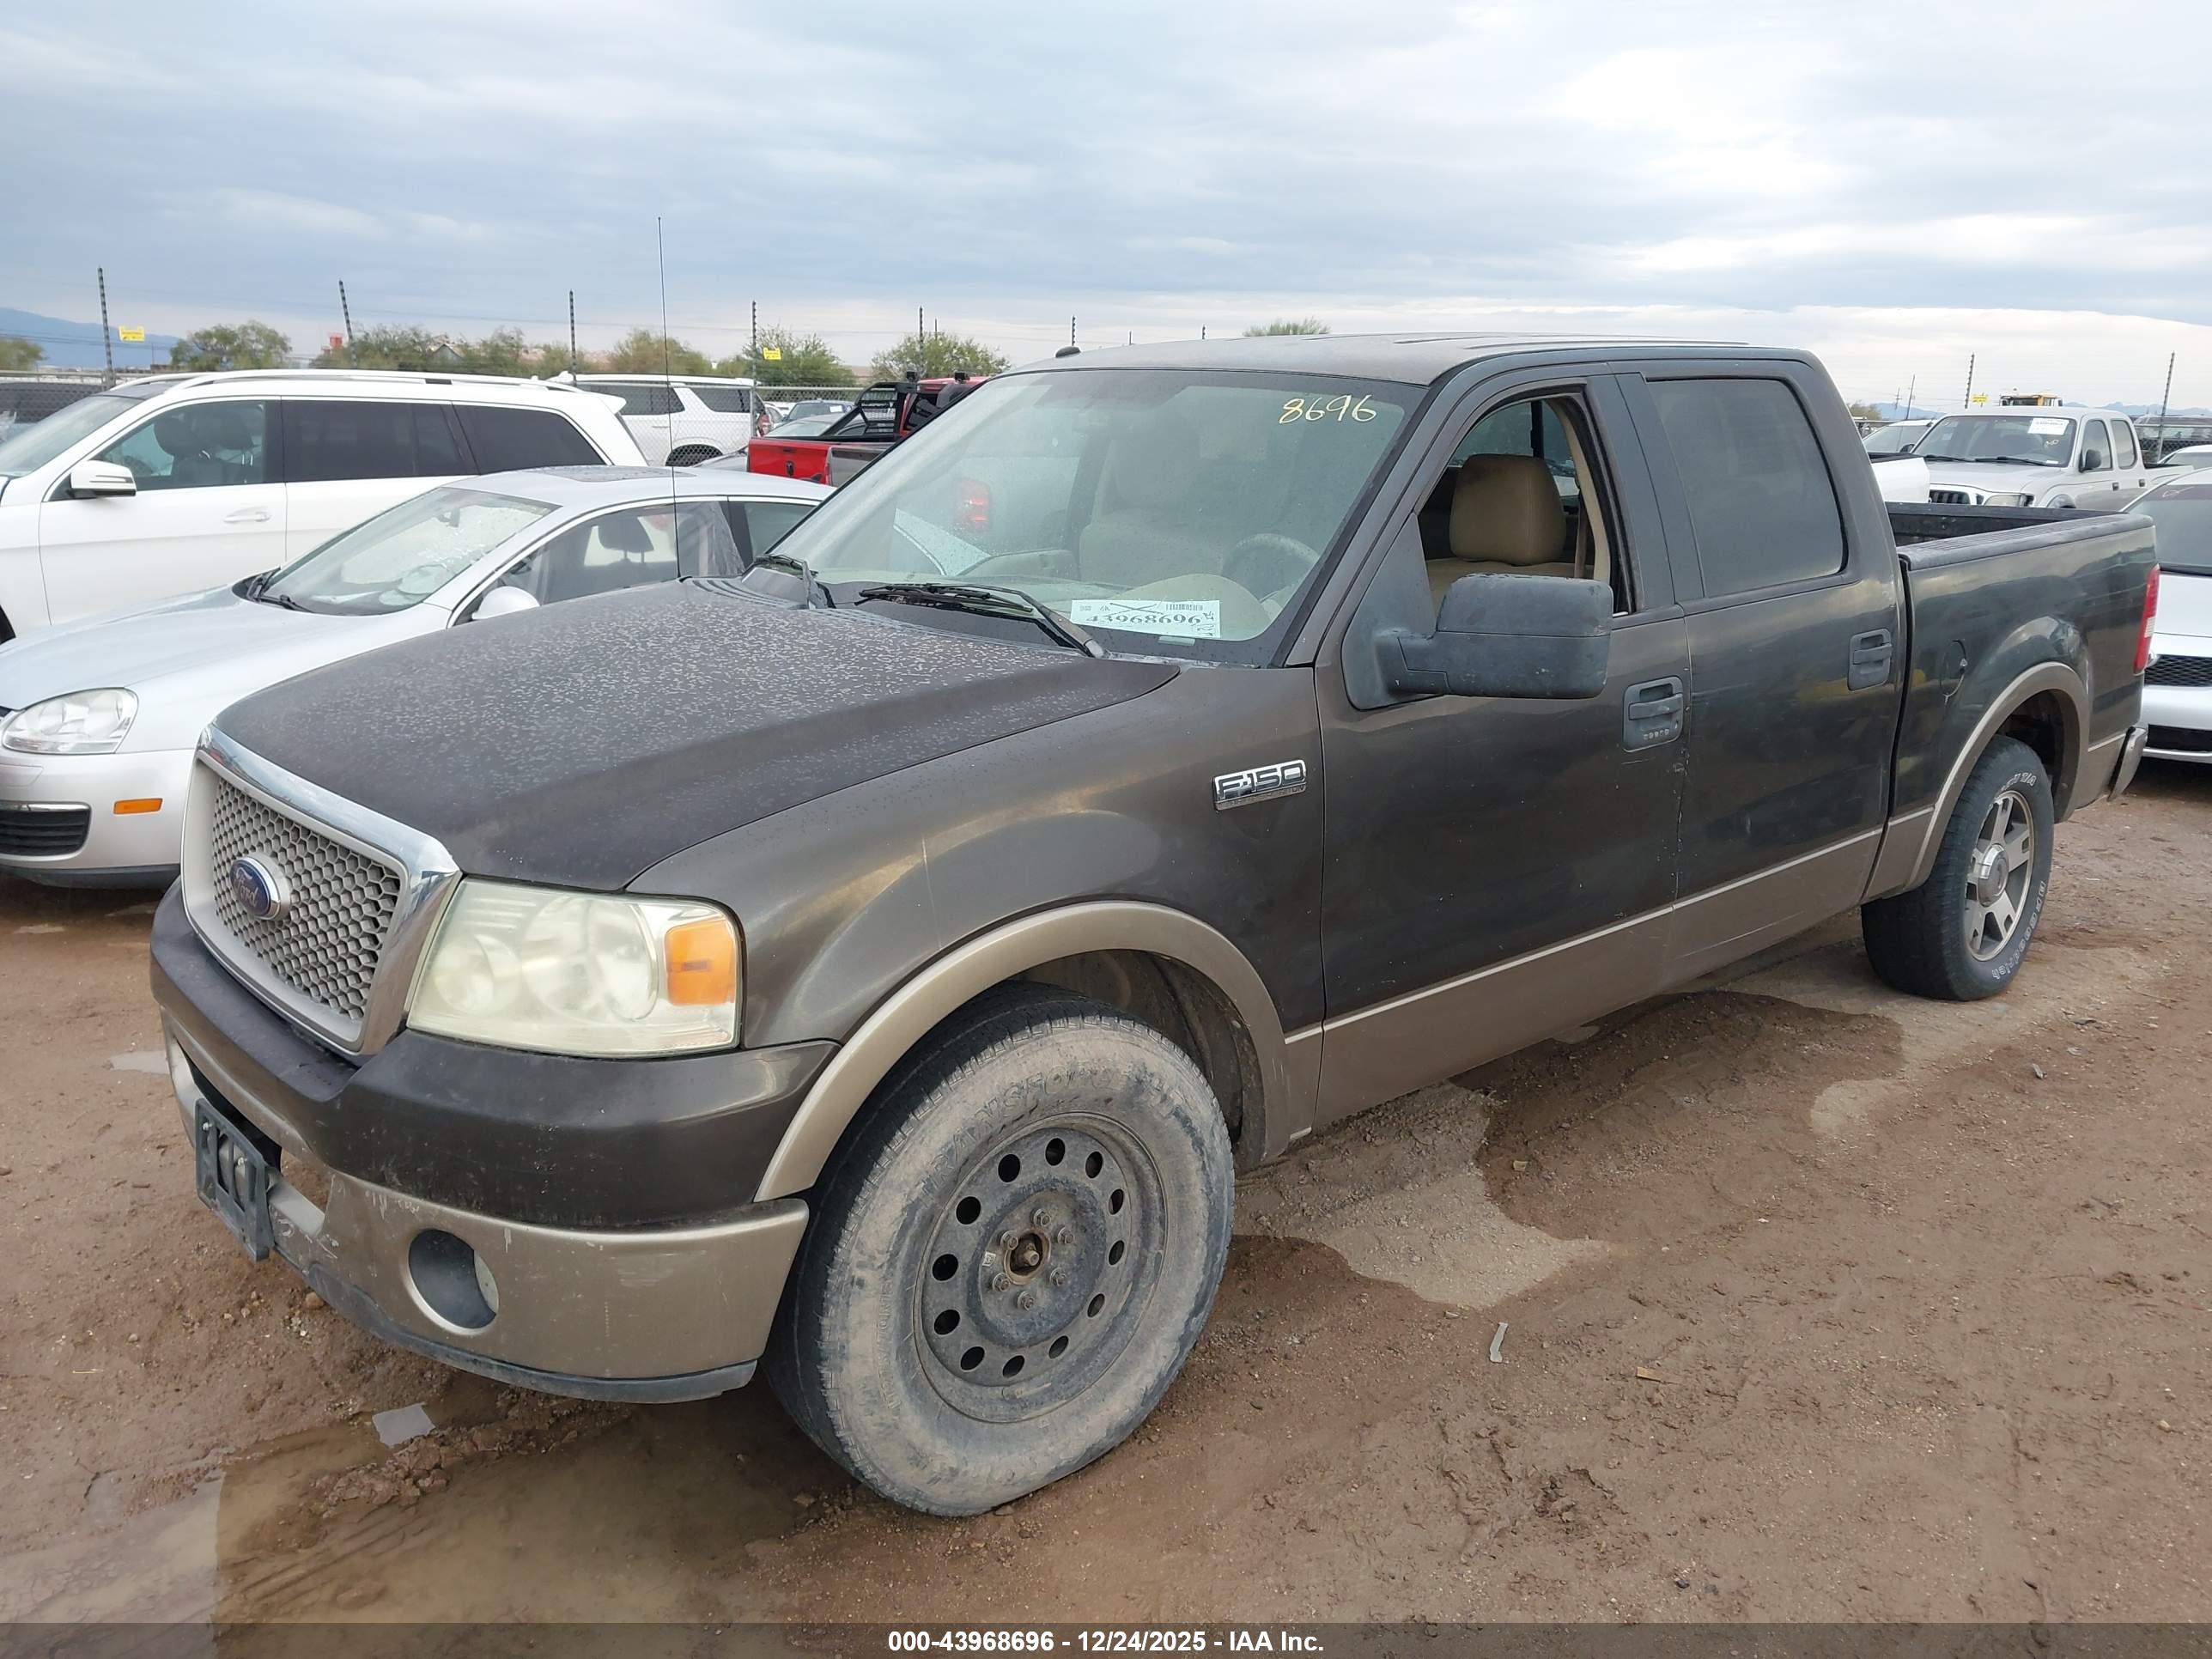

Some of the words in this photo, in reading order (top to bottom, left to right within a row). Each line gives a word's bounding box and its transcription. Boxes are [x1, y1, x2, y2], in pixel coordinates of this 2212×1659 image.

[1279, 394, 1377, 424] 8696
[1085, 613, 1202, 625] 43968696
[235, 866, 259, 908] Ford
